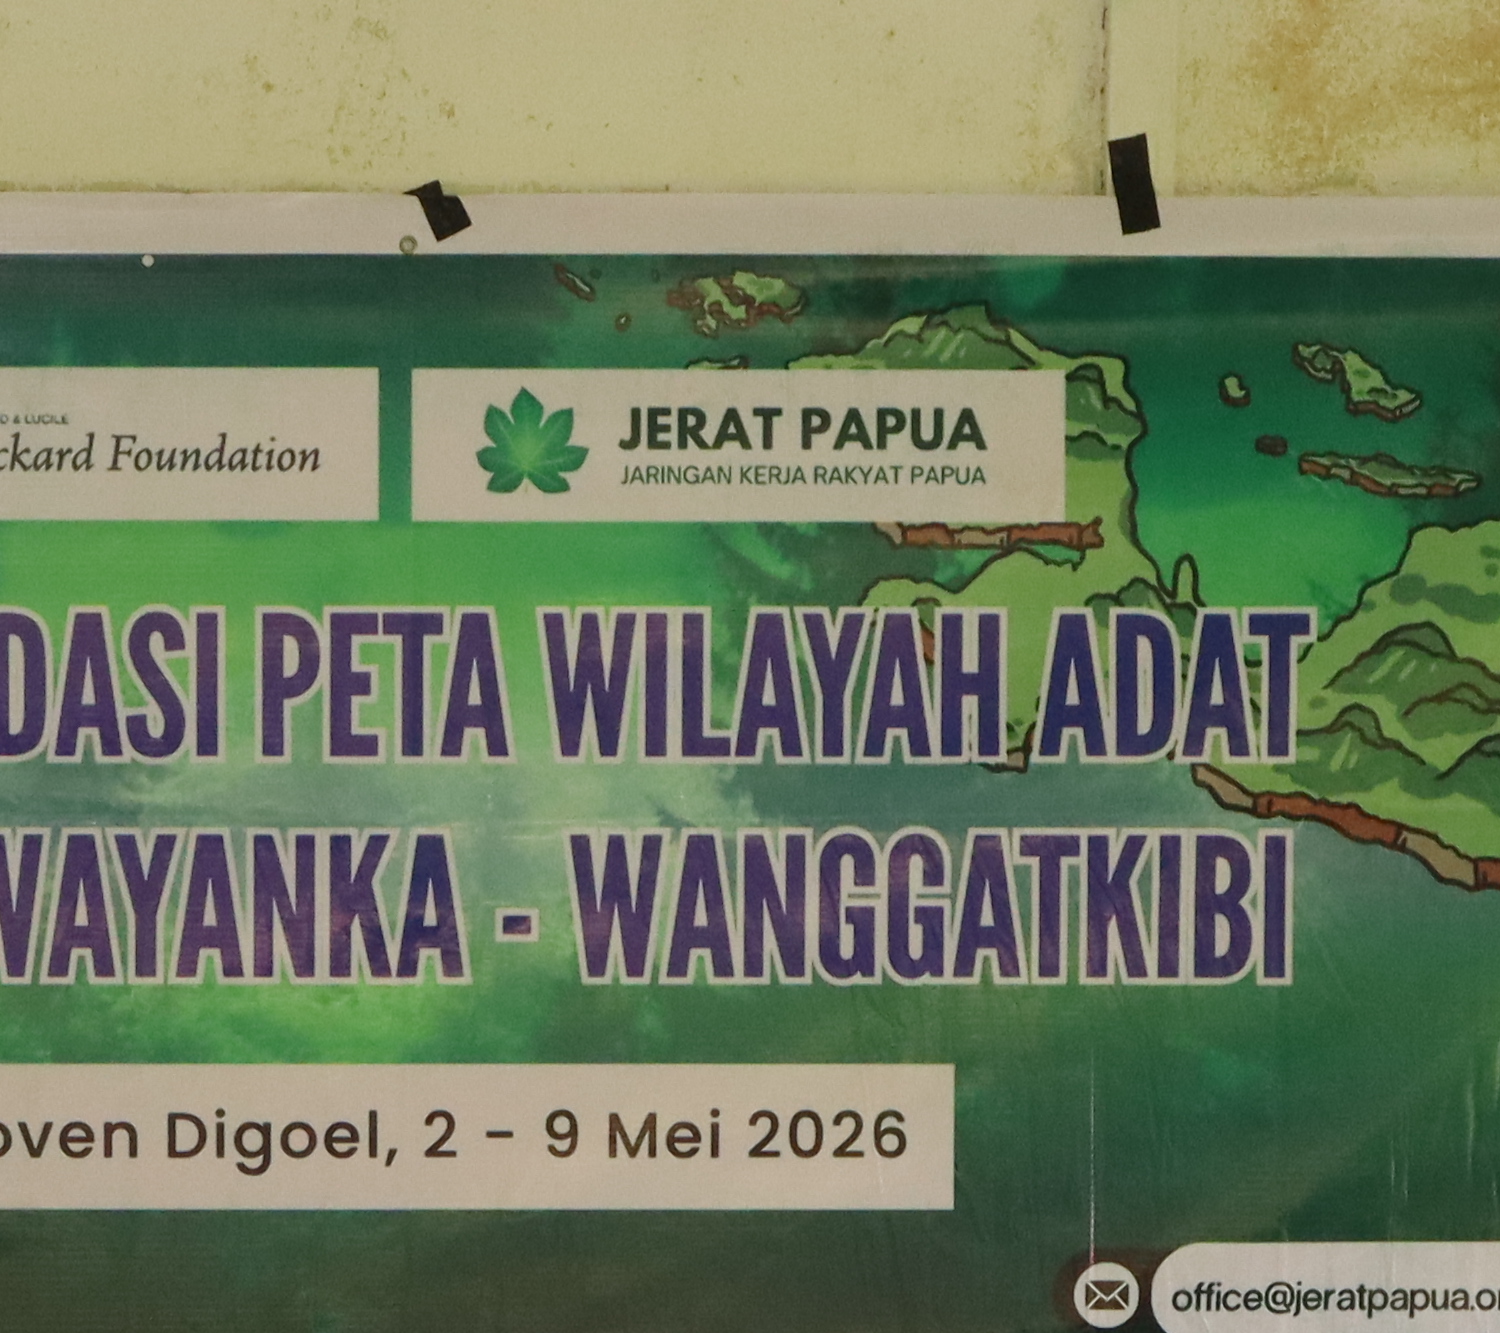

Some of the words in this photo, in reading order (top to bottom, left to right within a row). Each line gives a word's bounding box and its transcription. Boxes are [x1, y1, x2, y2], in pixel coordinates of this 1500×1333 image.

[13, 414, 21, 424] &
[25, 413, 69, 424] LUCILE
[618, 407, 783, 450] JERAT
[801, 407, 988, 450] PAPUA
[107, 432, 321, 472] Foundation
[621, 465, 732, 485] JARINGAN
[739, 465, 807, 485] KERJA
[814, 465, 903, 485] RAKYAT
[911, 465, 987, 485] PAPUA
[256, 604, 511, 764] PETA
[536, 604, 1004, 764] WILAYAH
[1034, 604, 1319, 764] ADAT
[499, 902, 542, 946] -
[563, 827, 1293, 990] WANGGATKIBI
[166, 1108, 398, 1176] Digoel,
[423, 1109, 458, 1158] 2
[544, 1109, 580, 1158] 9
[607, 1108, 721, 1158] Mei
[747, 1109, 908, 1158] 2026
